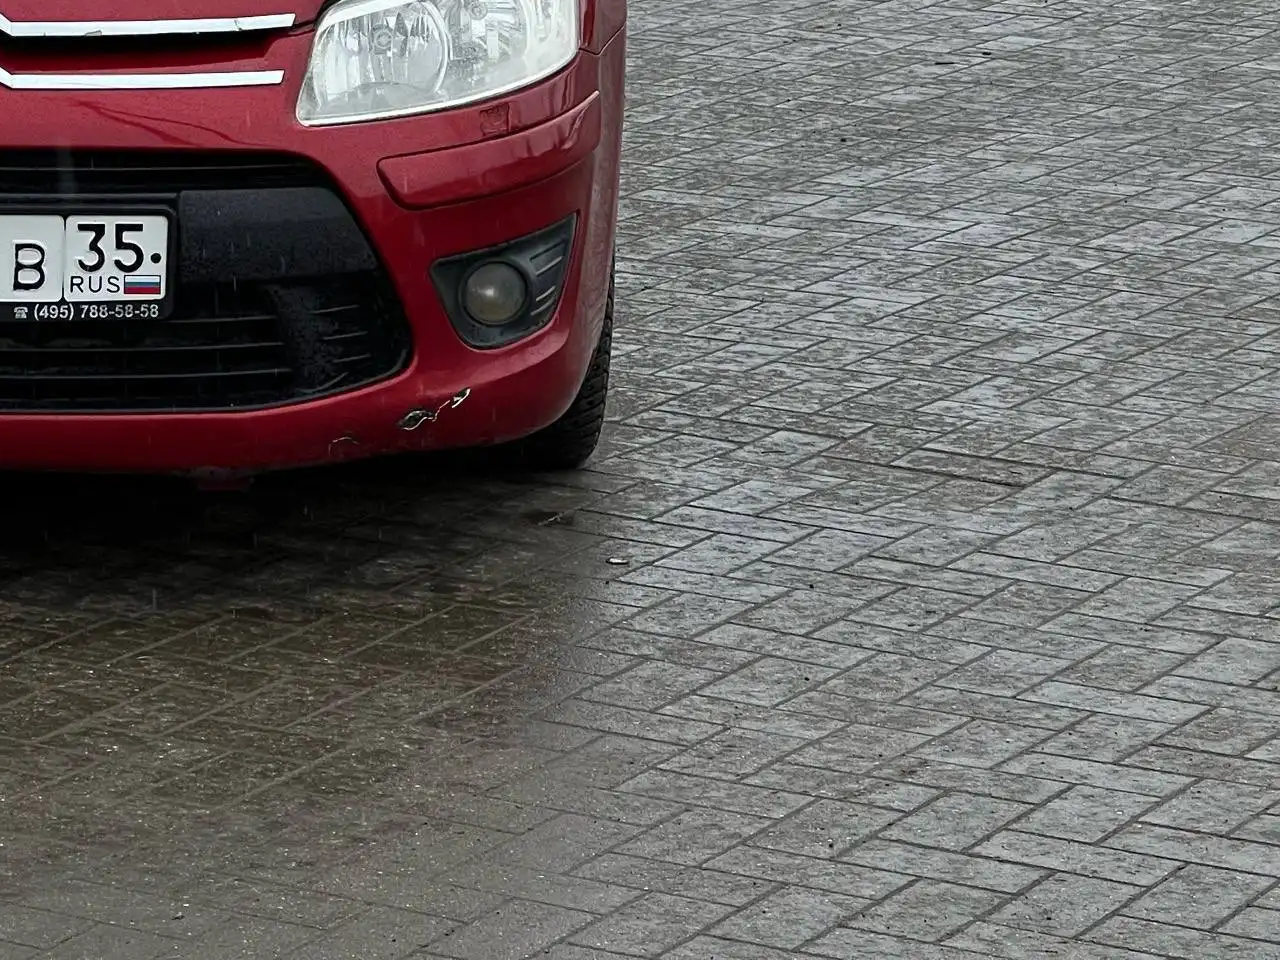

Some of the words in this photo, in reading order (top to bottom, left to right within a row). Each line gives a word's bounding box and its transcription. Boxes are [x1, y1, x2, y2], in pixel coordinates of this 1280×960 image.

[76, 223, 145, 273] 35
[70, 275, 121, 294] RUS
[34, 303, 75, 321] (495)
[80, 304, 160, 319] 788-58-58
